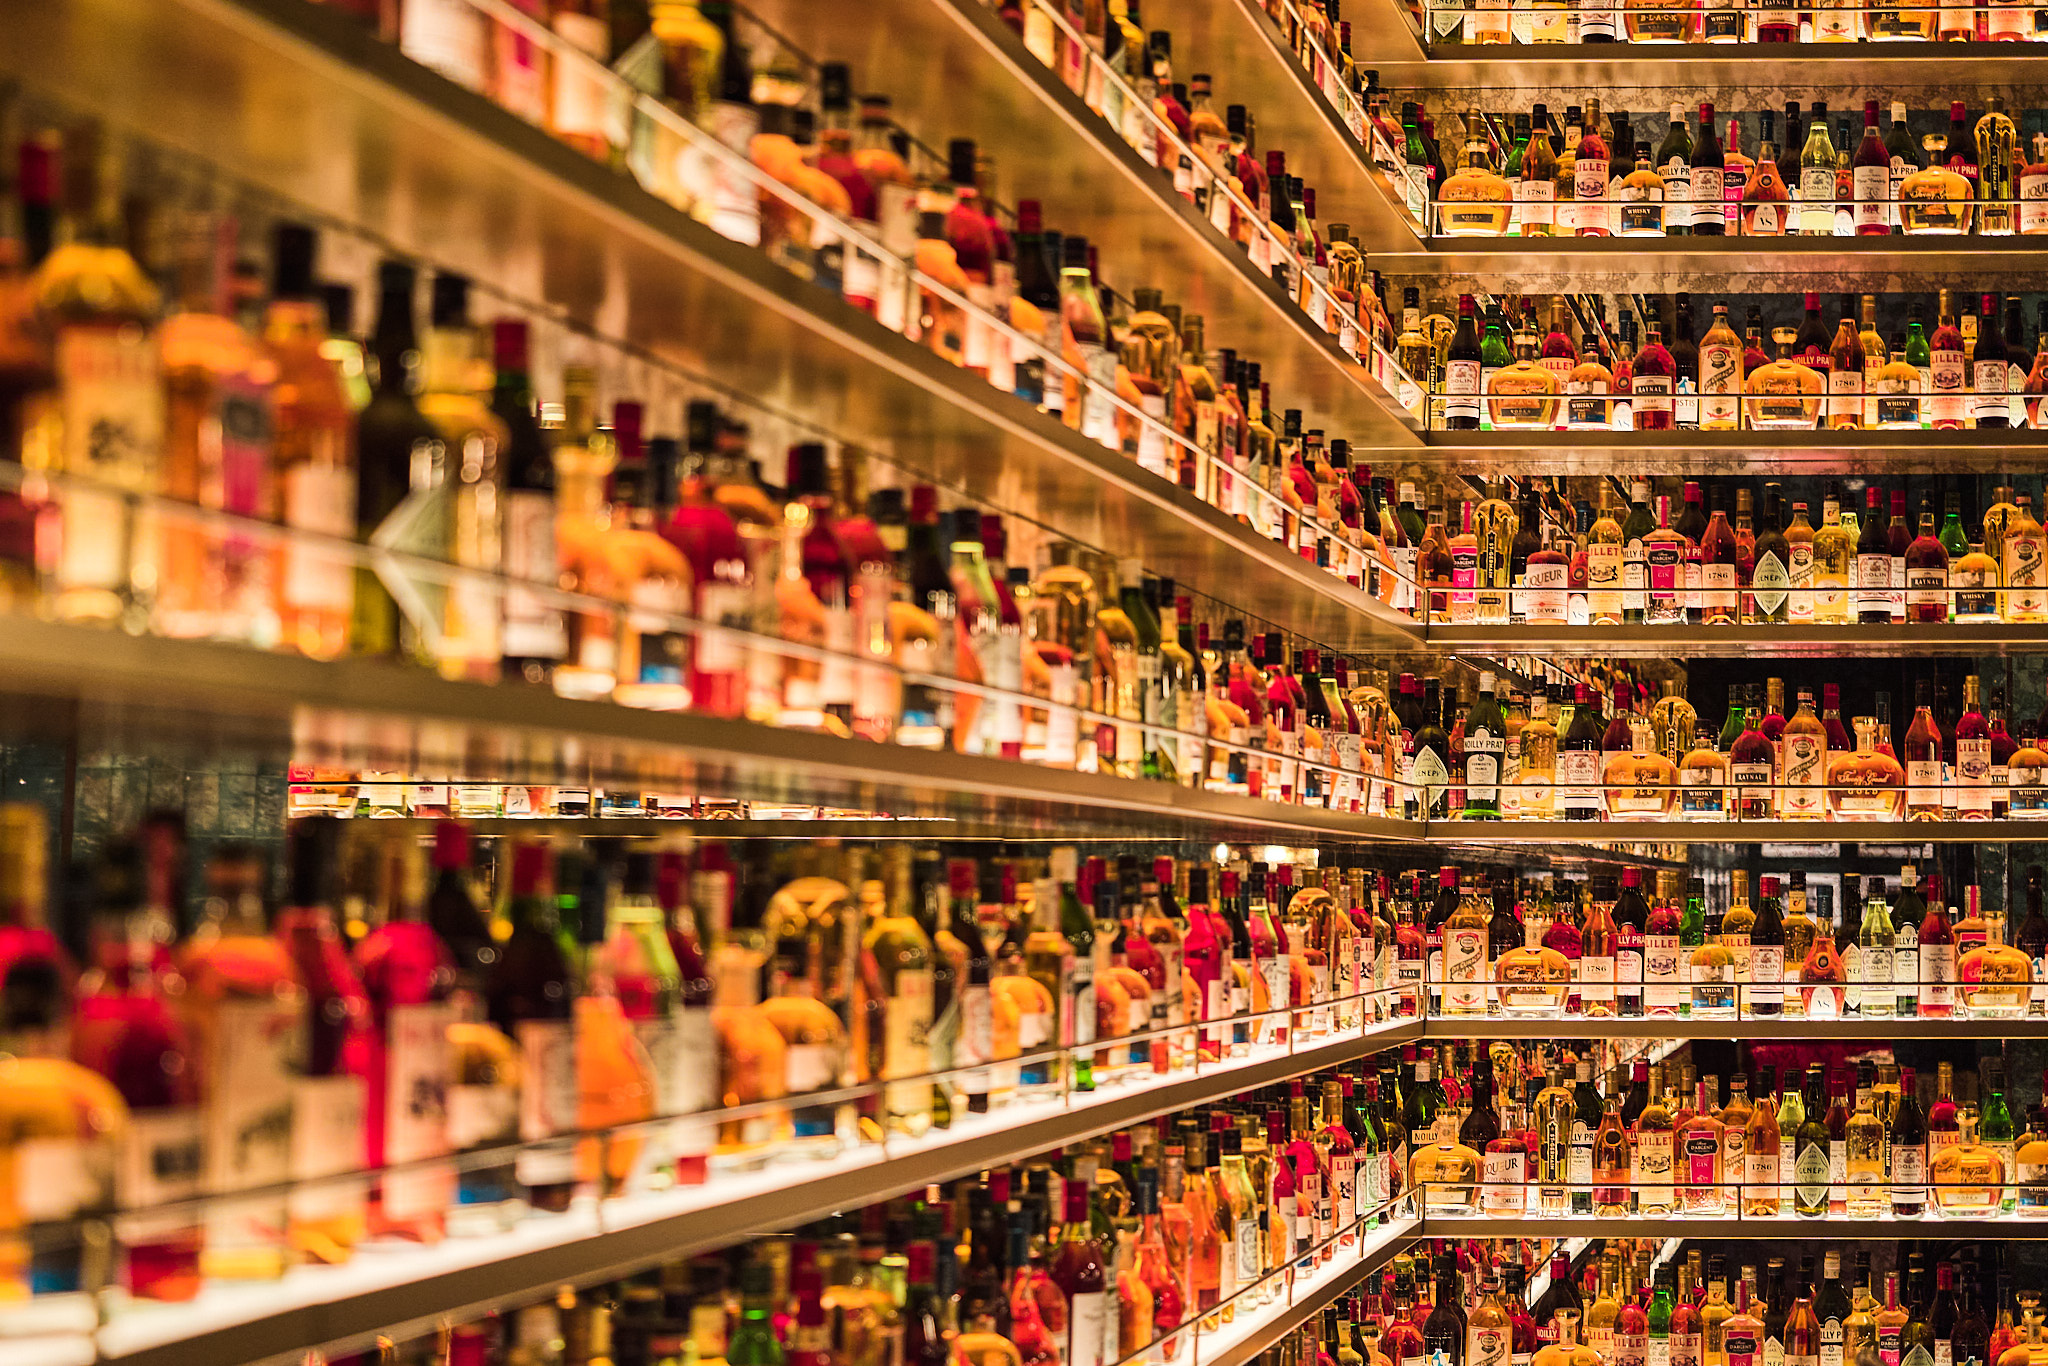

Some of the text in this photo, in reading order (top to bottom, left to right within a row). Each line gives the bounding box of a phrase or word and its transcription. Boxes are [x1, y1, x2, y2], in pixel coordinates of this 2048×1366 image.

[1576, 163, 1607, 172] LILLET
[1681, 167, 1690, 175] PR
[1627, 207, 1650, 215] WHISKY
[1817, 356, 1829, 365] PRA
[1932, 354, 1963, 364] LILLET
[1590, 547, 1618, 556] ILLET
[1486, 740, 1503, 748] PRAT
[1646, 939, 1678, 948] LILLET
[1722, 938, 1749, 946] LILLE
[1639, 1136, 1671, 1146] LILLET
[1931, 1135, 1959, 1144] LILLE
[1590, 1332, 1614, 1340] LILL
[1614, 1337, 1647, 1347] LILLET
[1670, 1337, 1698, 1347] ILLET
